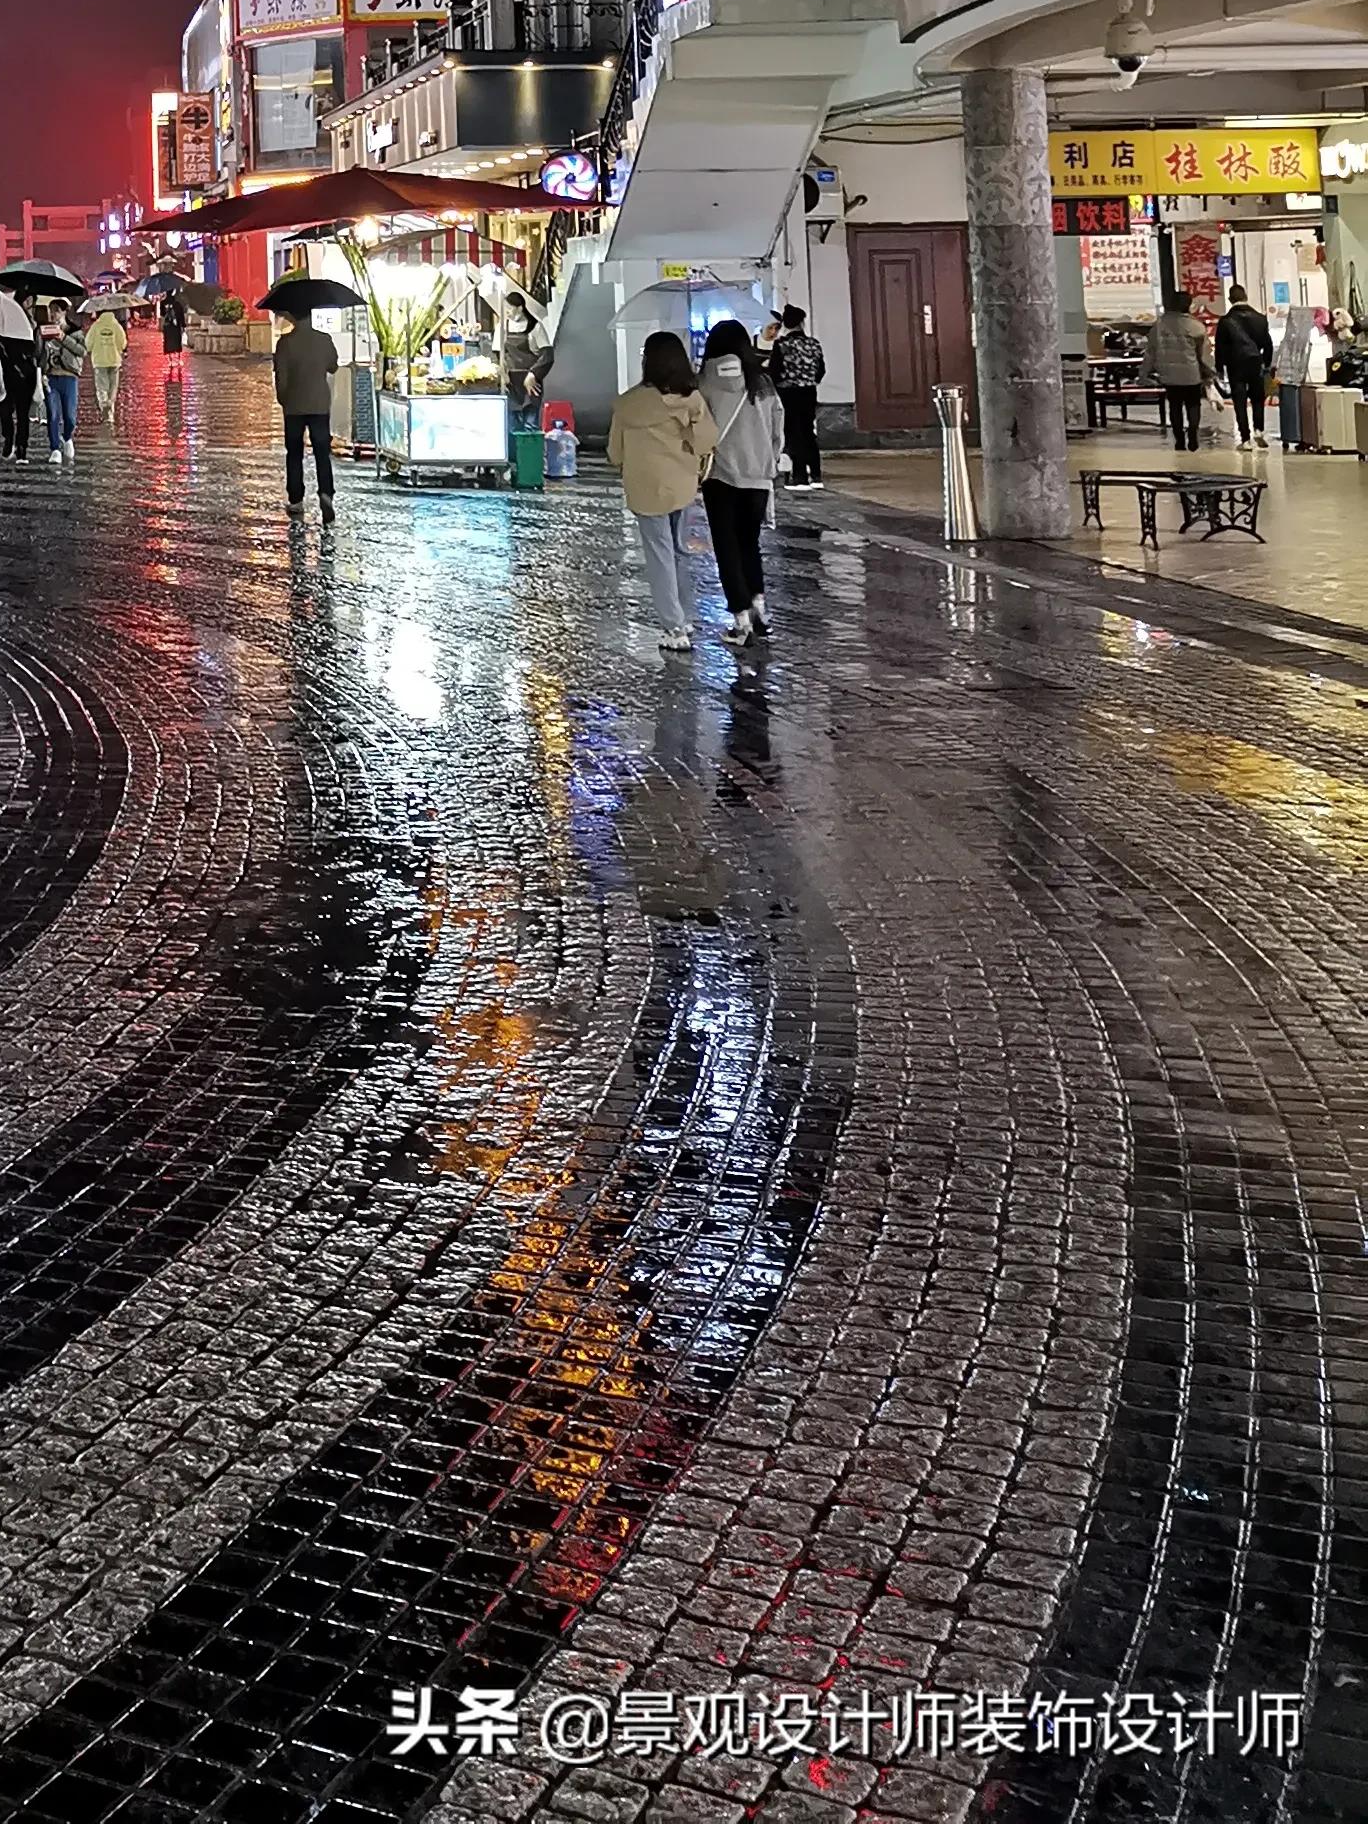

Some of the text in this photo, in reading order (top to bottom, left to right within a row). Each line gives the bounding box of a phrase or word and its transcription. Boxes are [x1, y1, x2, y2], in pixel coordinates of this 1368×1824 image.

[1063, 139, 1135, 170] 利店
[1162, 140, 1309, 186] 桂林酸
